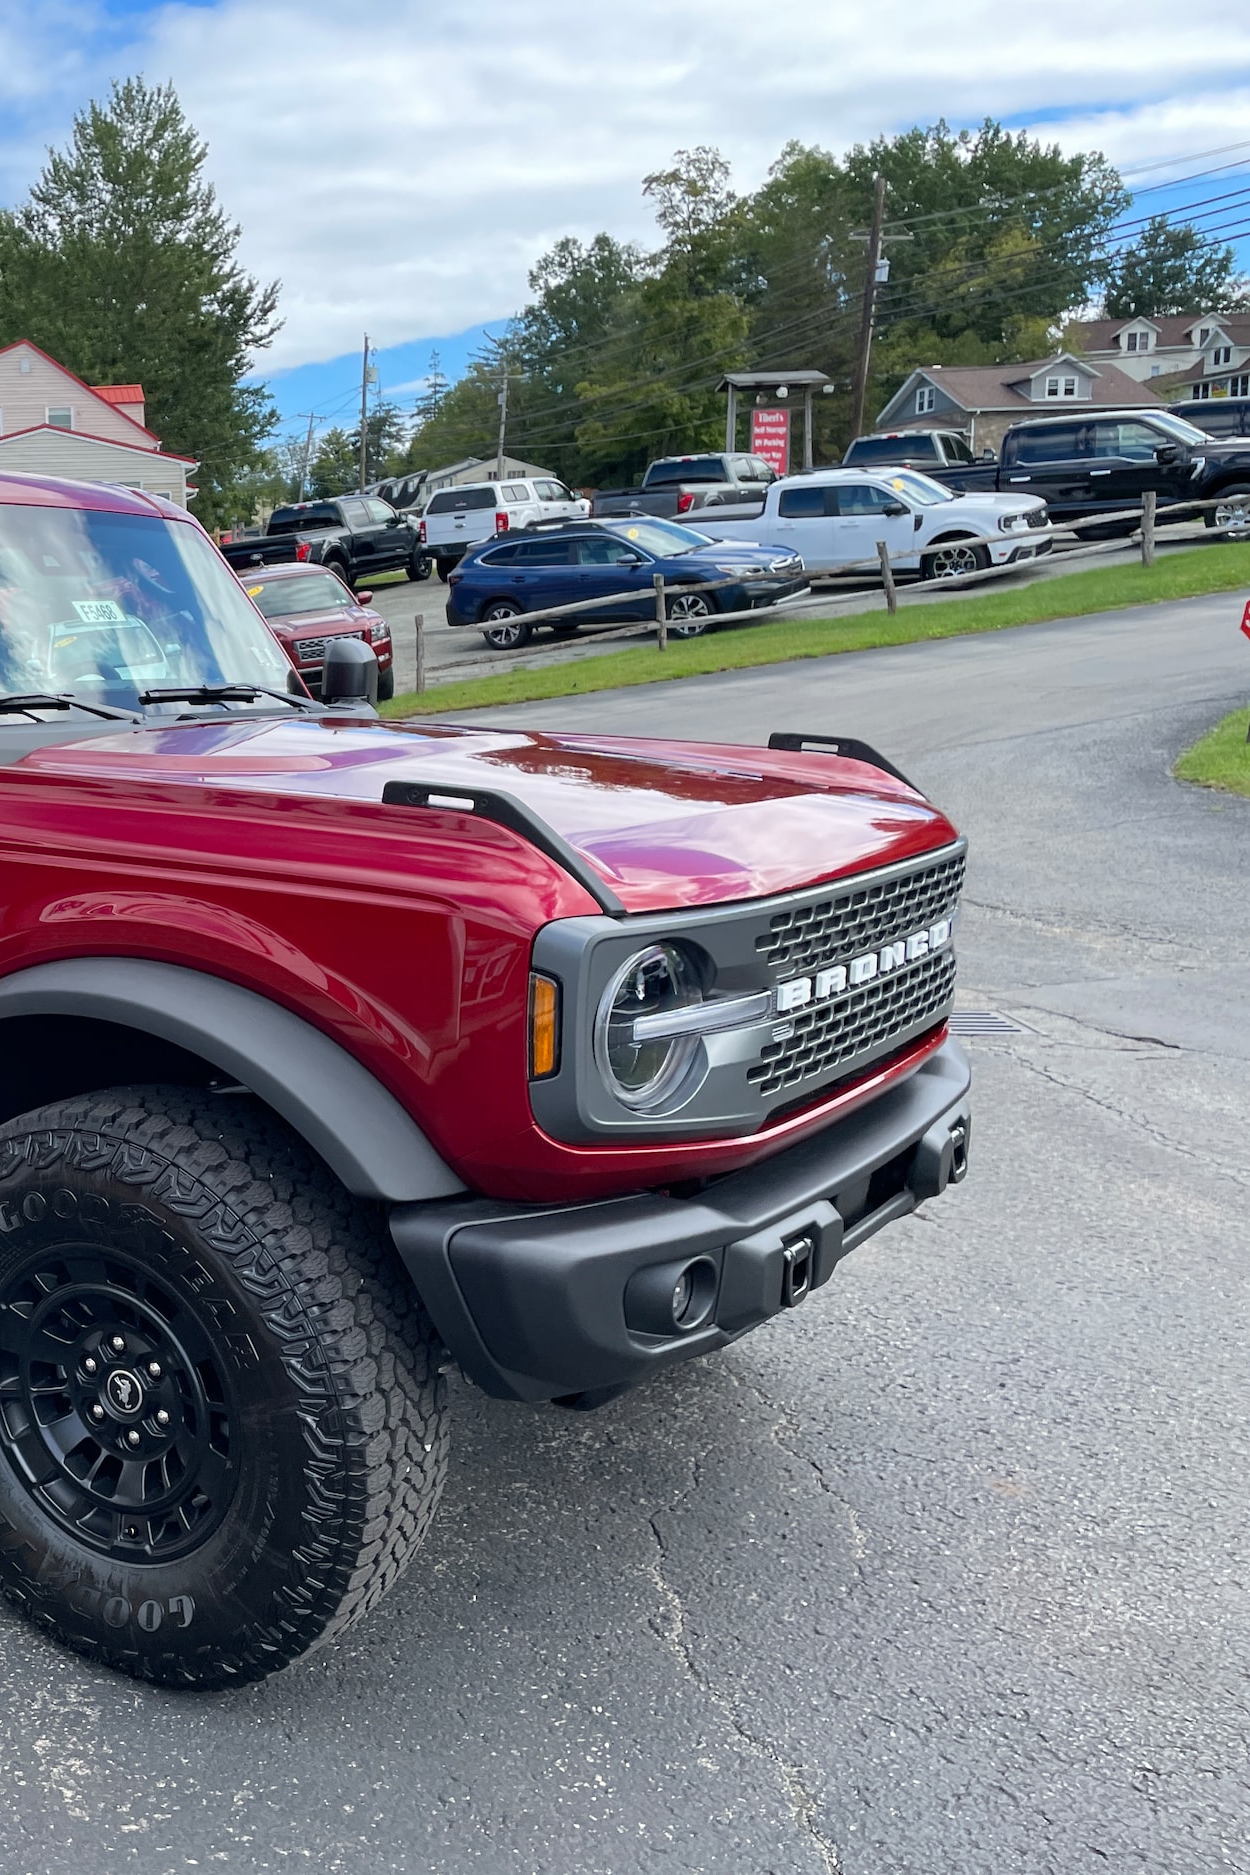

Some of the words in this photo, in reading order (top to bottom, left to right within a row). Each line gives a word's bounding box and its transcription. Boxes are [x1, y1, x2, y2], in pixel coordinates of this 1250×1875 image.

[753, 426, 765, 434] Self
[766, 426, 787, 435] Storage
[763, 439, 785, 447] Parking
[80, 604, 118, 621] F5468
[777, 920, 949, 1012] BRONCO
